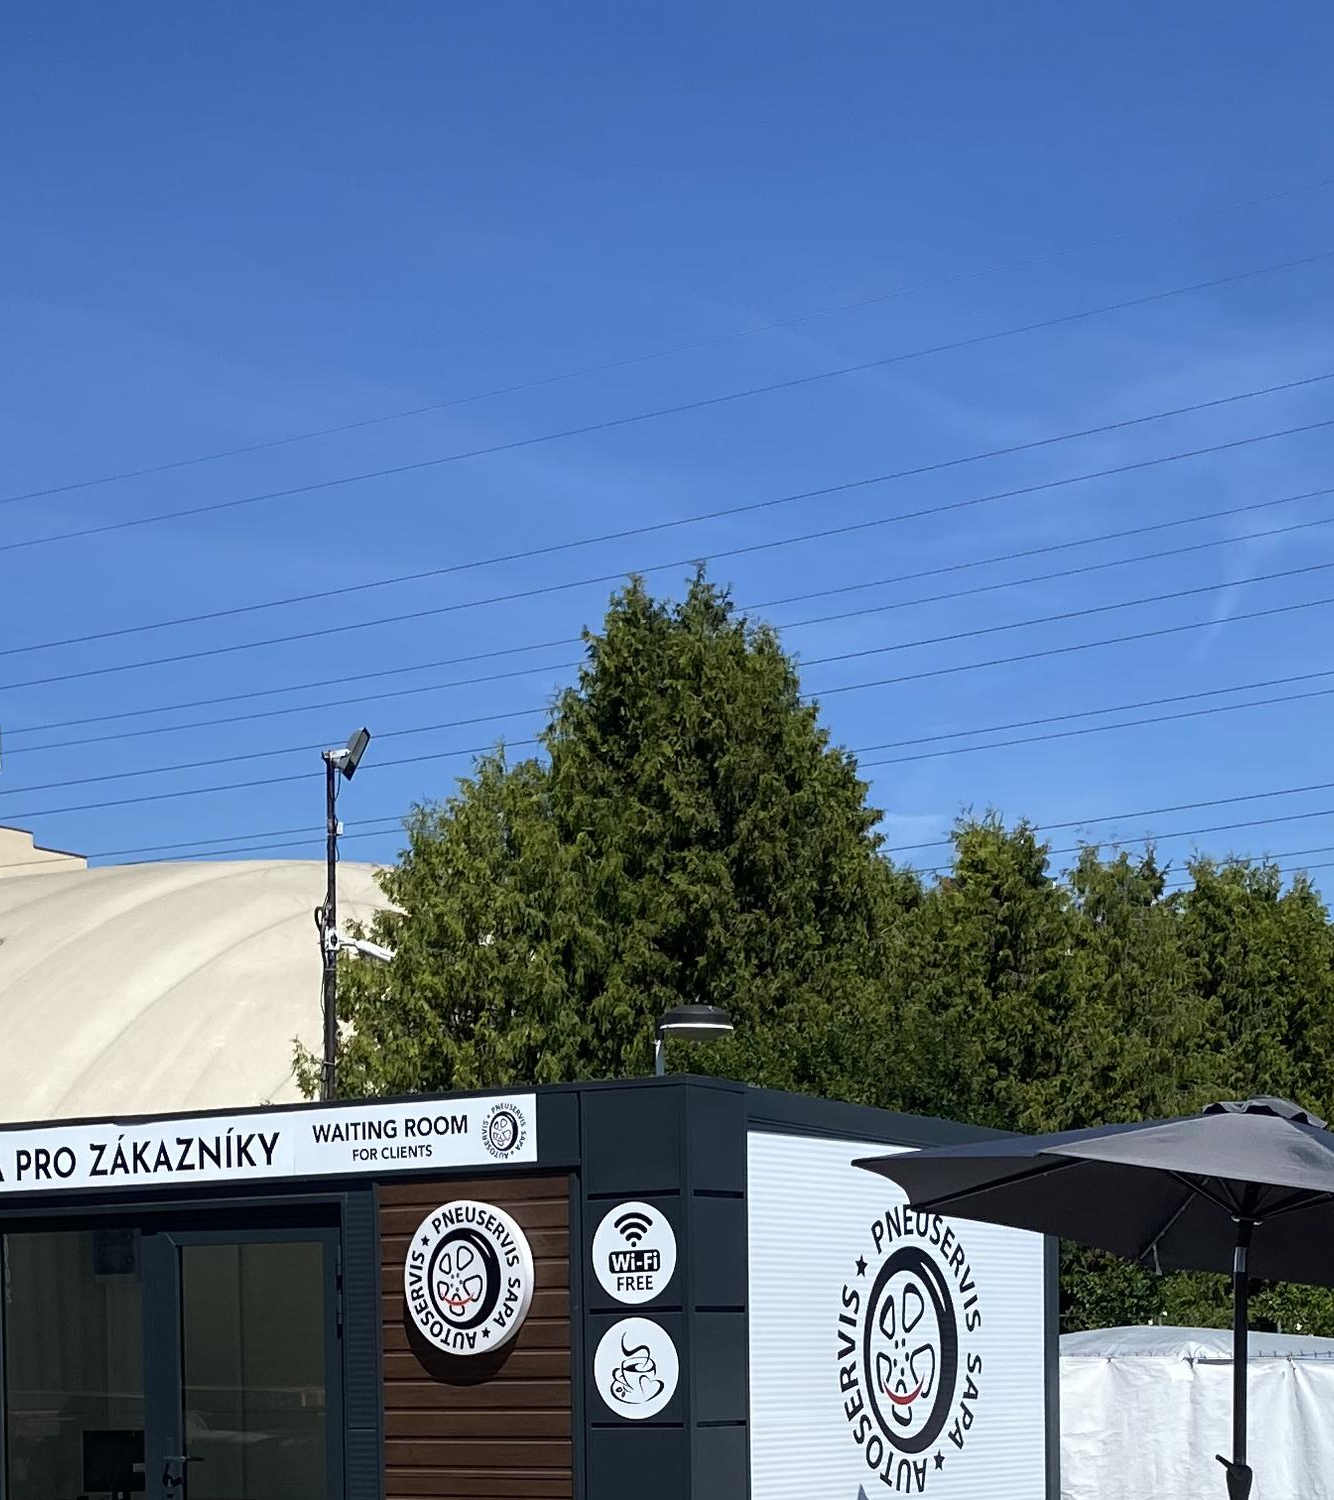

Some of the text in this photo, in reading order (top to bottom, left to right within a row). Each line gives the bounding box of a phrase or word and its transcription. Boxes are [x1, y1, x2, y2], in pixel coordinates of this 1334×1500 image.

[16, 1147, 76, 1181] PRO
[89, 1127, 280, 1176] ZÁKAZNÍKY
[312, 1115, 467, 1143] WAITING ROOM
[352, 1145, 432, 1161] FOR CLIENTS
[431, 1206, 521, 1328] PNEUSERVIS SAPA
[610, 1251, 660, 1273] Wi-Fi
[616, 1275, 654, 1292] FREE
[408, 1250, 478, 1350] AUTOSERVIS
[871, 1204, 982, 1450] PNEUSERVIS SAPA
[837, 1285, 927, 1494] AUTOSERVIS
